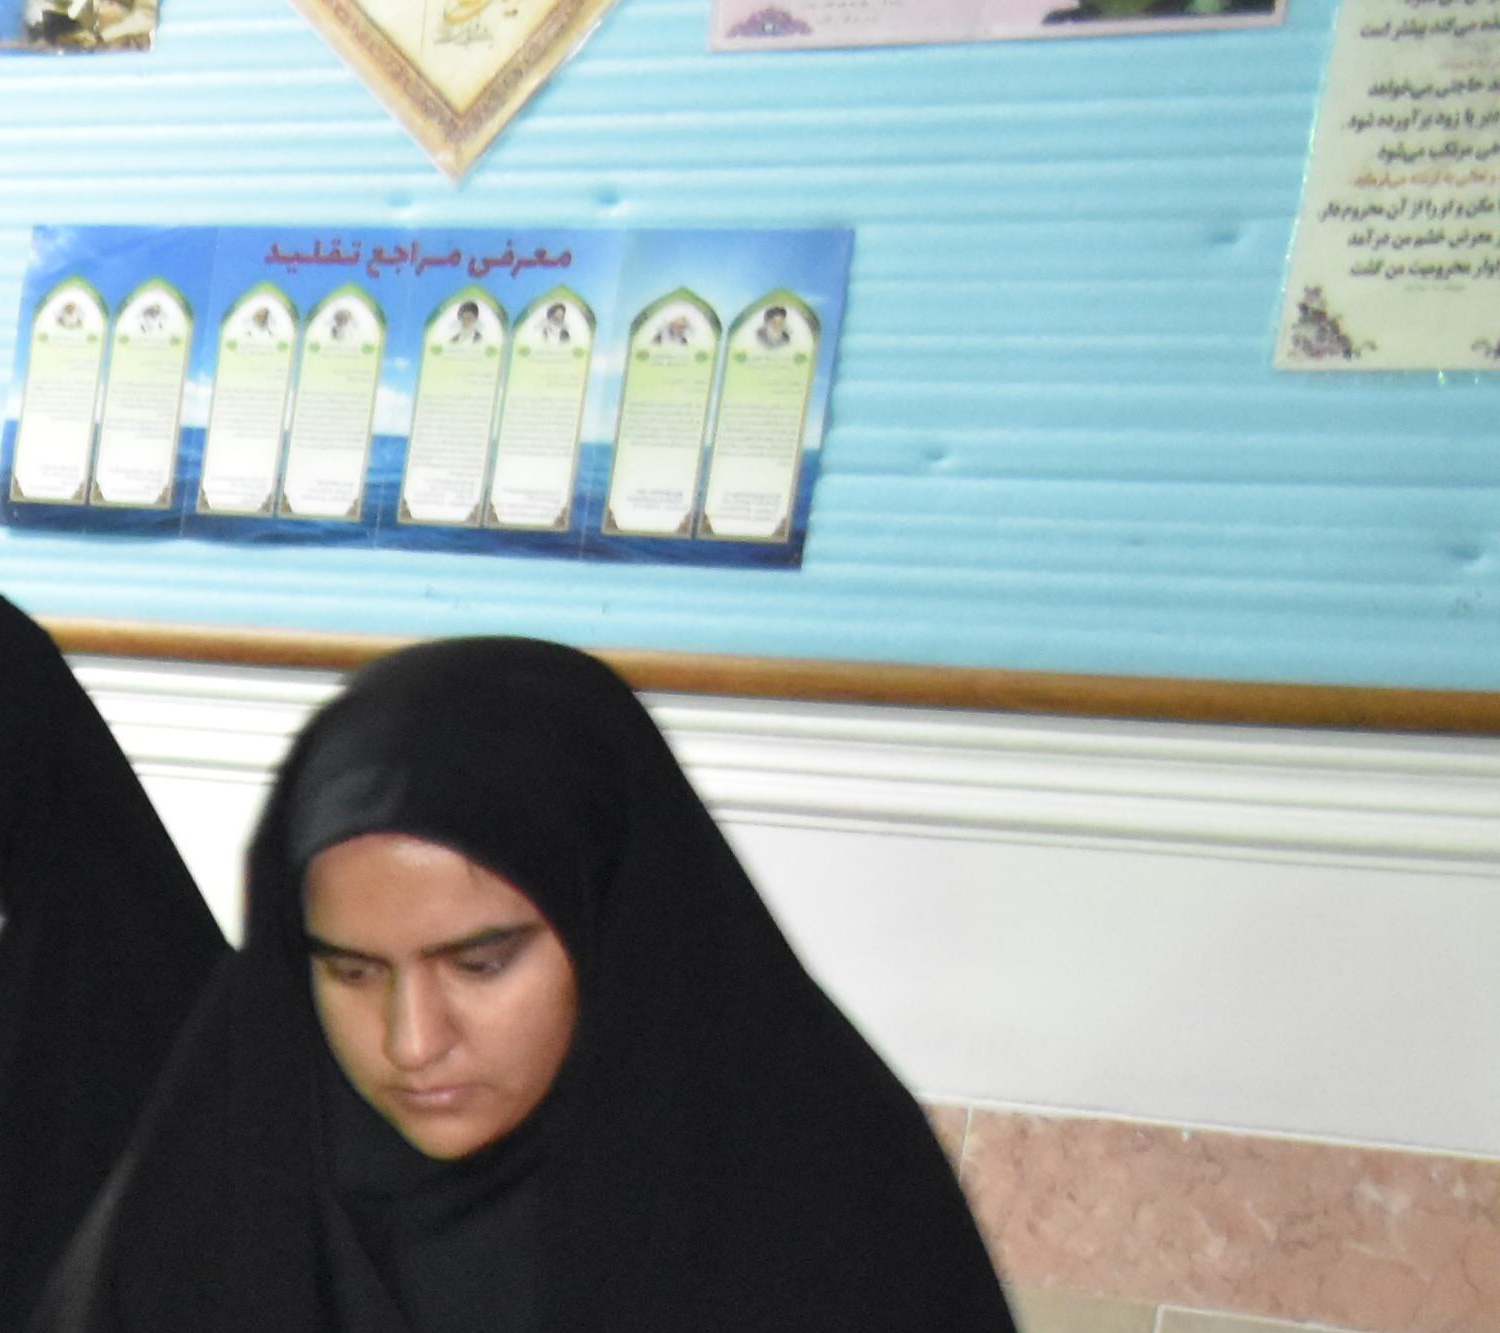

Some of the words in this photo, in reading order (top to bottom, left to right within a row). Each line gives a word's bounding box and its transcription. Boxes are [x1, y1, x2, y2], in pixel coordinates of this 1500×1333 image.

[265, 238, 362, 274] تقلید
[366, 239, 461, 279] مراجع
[467, 239, 572, 279] معرفی
